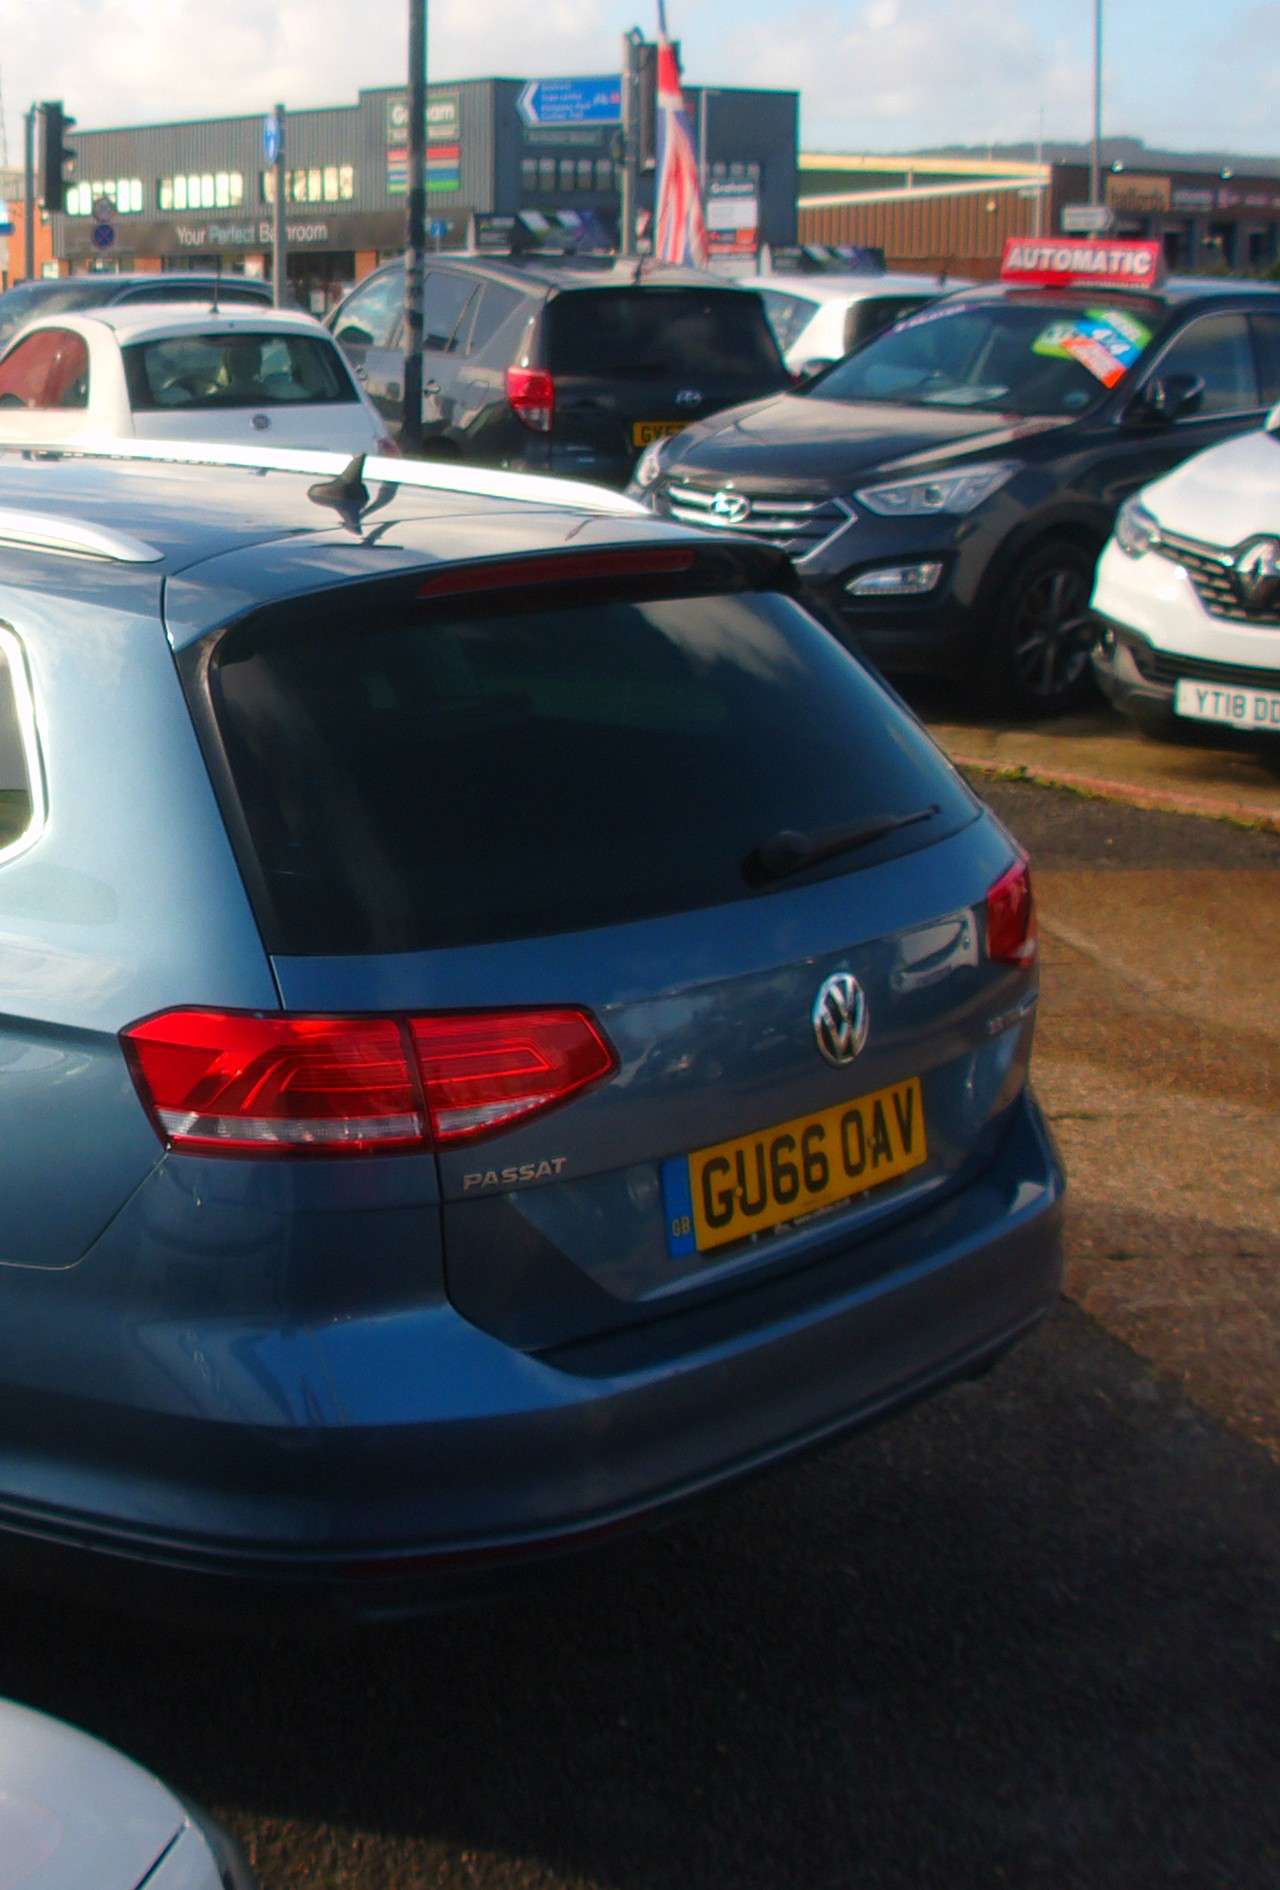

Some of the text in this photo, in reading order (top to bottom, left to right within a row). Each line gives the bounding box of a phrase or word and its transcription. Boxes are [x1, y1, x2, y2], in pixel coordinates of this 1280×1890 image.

[176, 221, 328, 246] Your Perfect Baroom
[1007, 246, 1153, 276] AUTOMATIC
[1195, 690, 1248, 719] YT18
[701, 1123, 830, 1230] GU66
[839, 1086, 914, 1179] OAV
[463, 1156, 568, 1193] PASSAT
